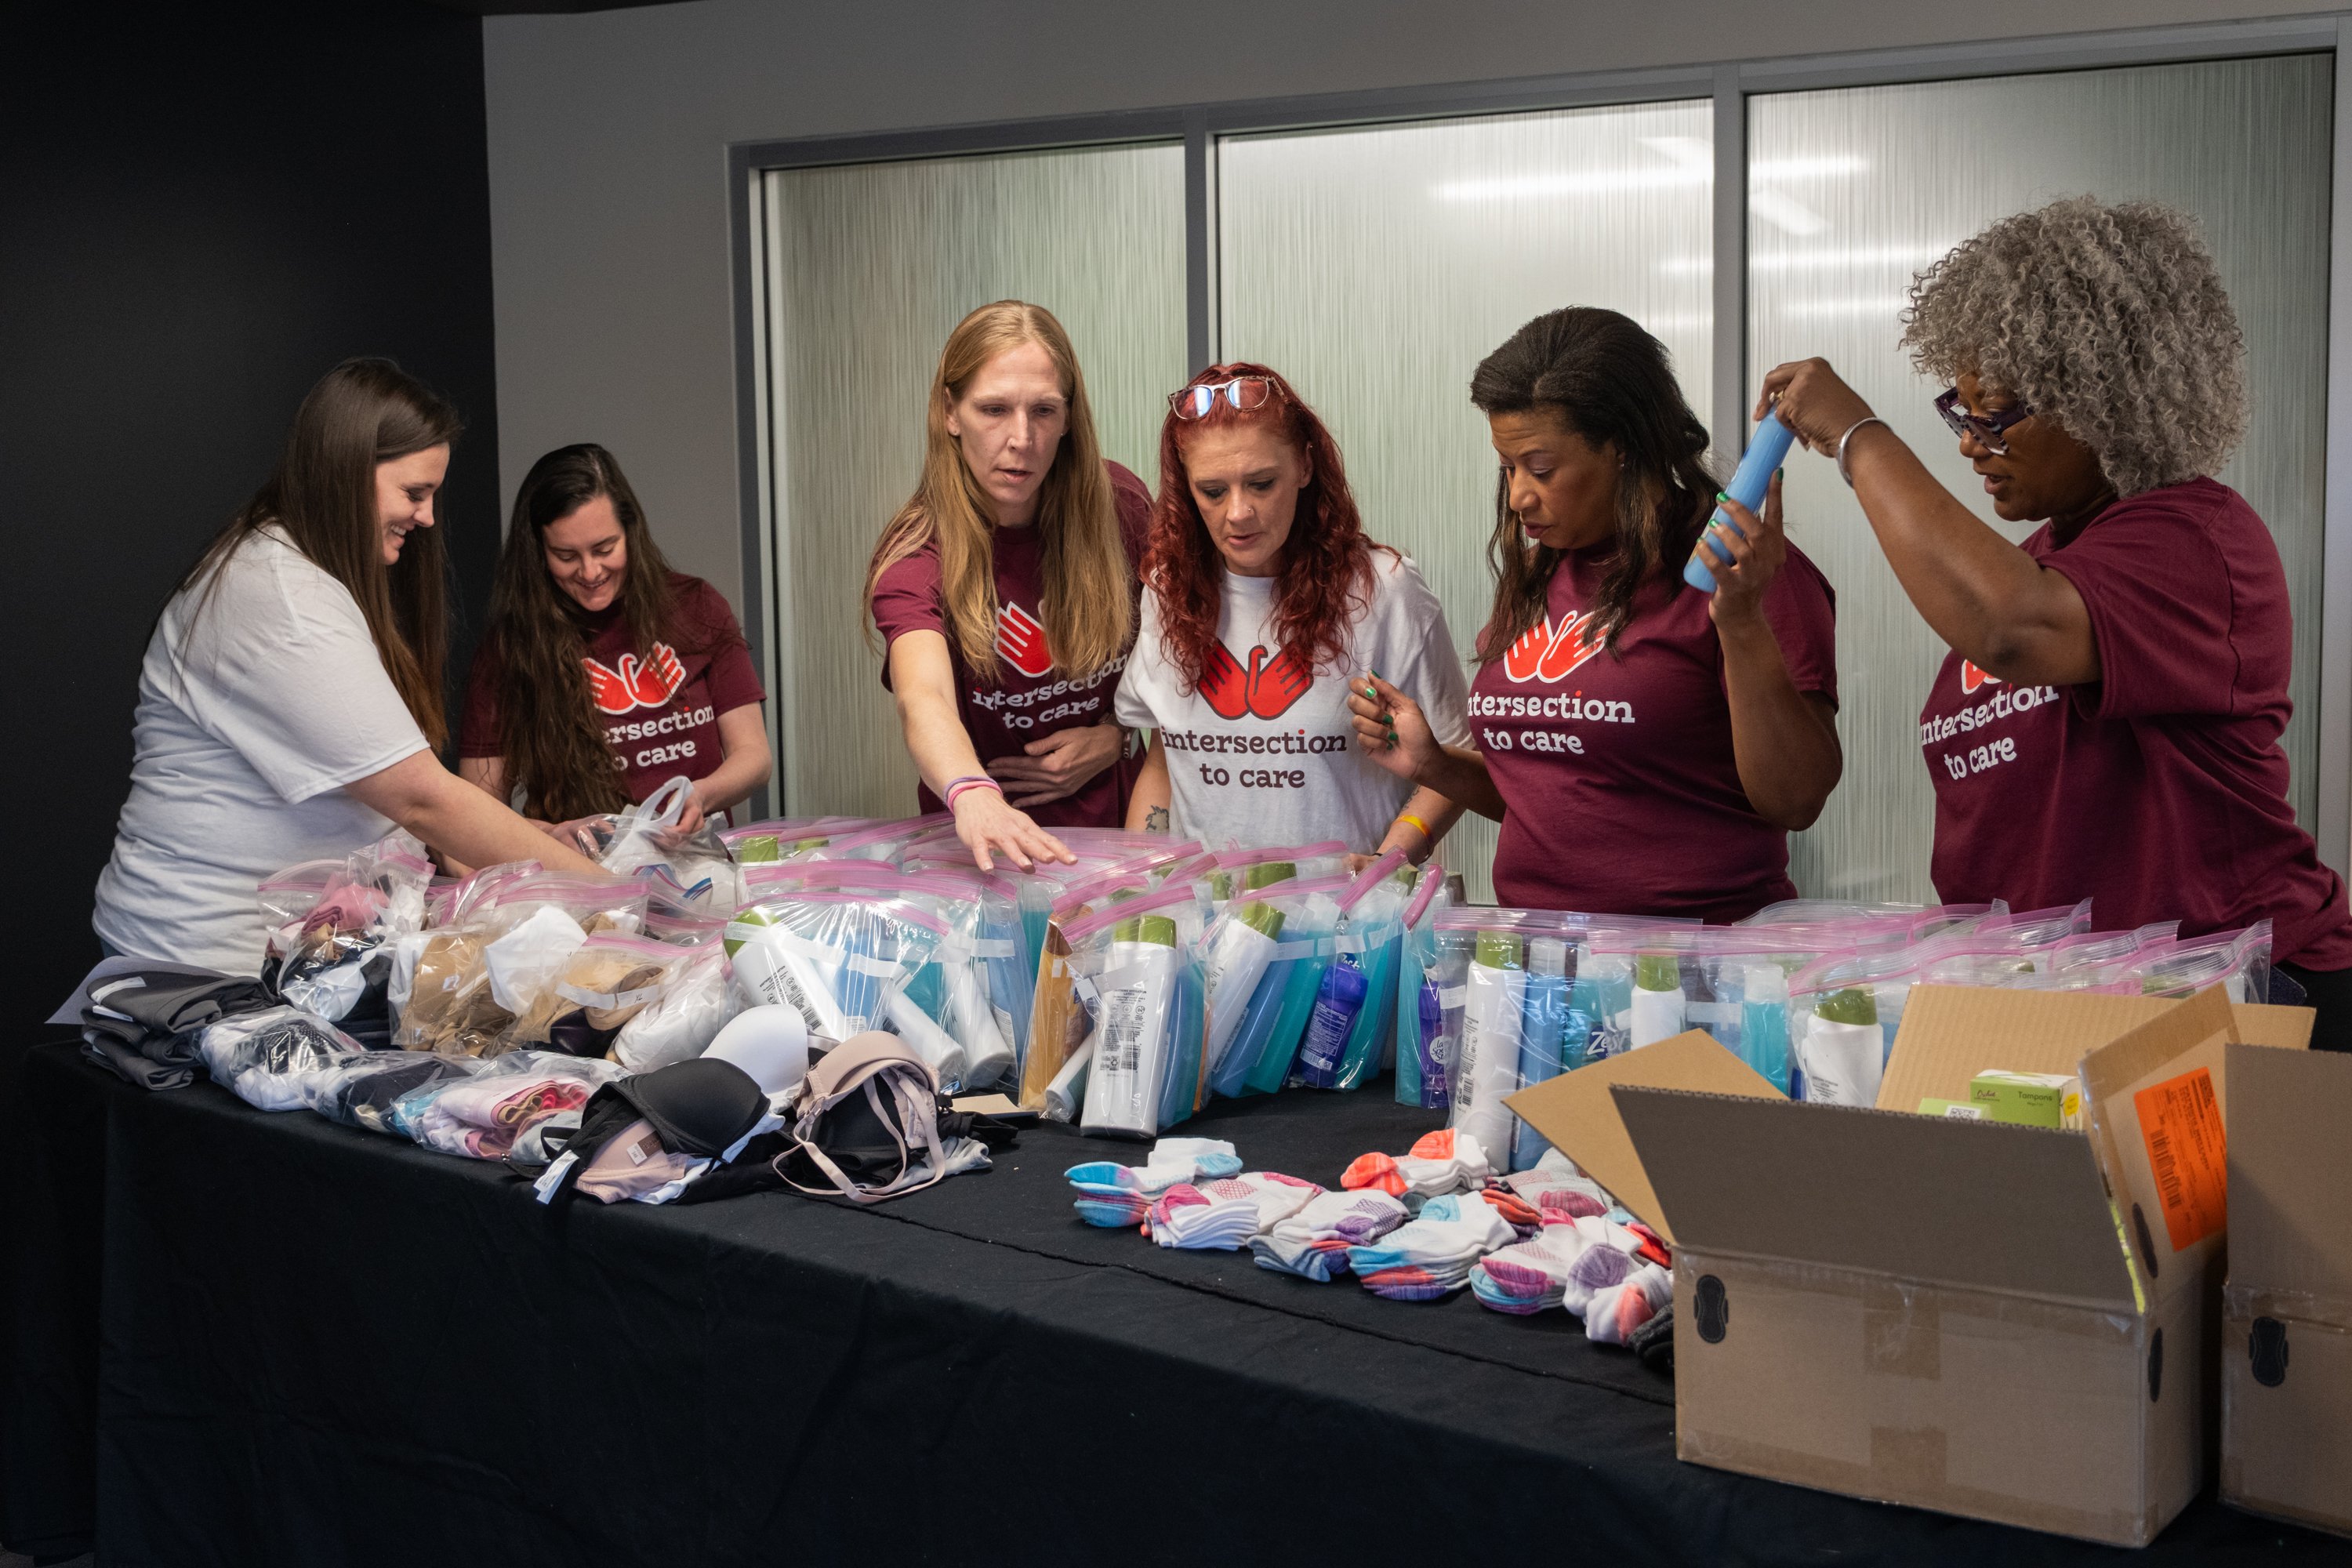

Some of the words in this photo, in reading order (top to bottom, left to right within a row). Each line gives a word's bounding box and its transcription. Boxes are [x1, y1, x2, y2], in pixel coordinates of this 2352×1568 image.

[1003, 712, 1034, 729] to
[1038, 696, 1100, 723] care
[1467, 690, 1635, 724] ntersection
[1920, 683, 2060, 746] intersection
[1161, 725, 1347, 754] intersection
[1483, 728, 1513, 750] to
[1519, 730, 1585, 755] care
[612, 755, 629, 771] o
[636, 740, 697, 768] care
[1944, 753, 1967, 781] to
[1969, 736, 2017, 774] care
[1199, 763, 1230, 786] to
[1239, 768, 1305, 789] care
[2018, 1091, 2053, 1102] Tampons
